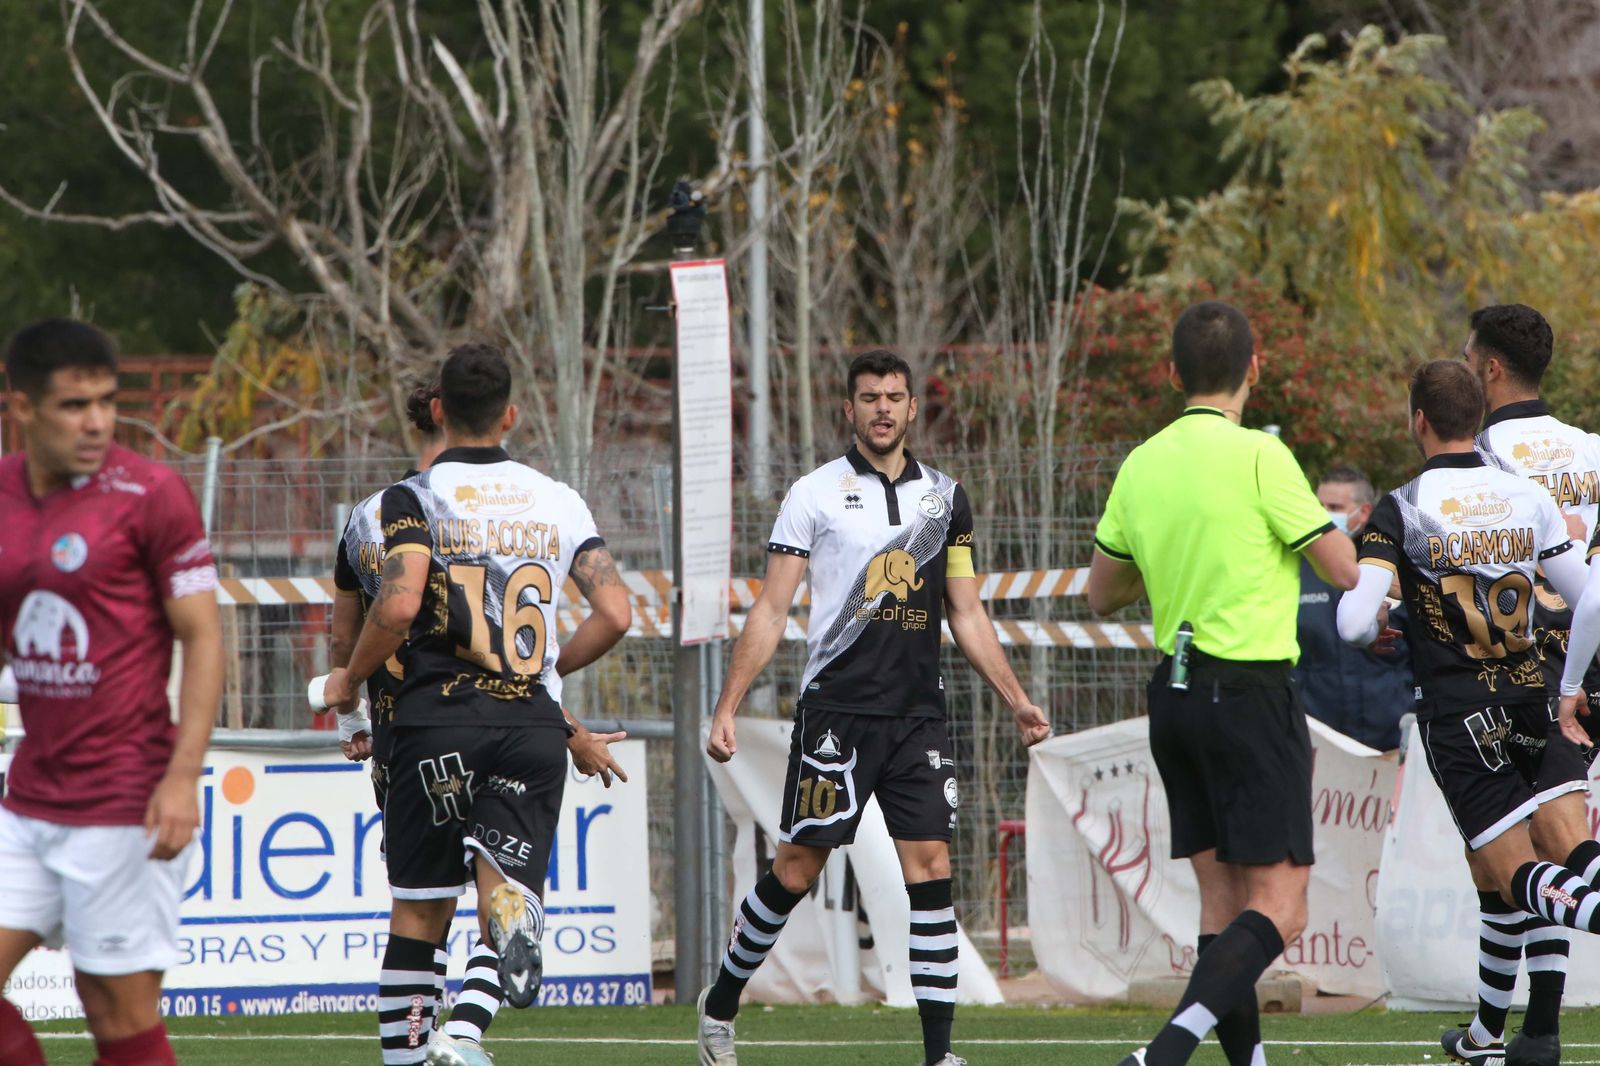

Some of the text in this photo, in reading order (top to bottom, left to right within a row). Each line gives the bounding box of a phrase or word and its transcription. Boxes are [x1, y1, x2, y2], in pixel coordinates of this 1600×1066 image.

[438, 518, 560, 561] LUIS ACOSTA
[1428, 527, 1534, 569] P.CARMONA
[448, 562, 552, 676] 16
[902, 621, 927, 631] grupo
[1439, 571, 1534, 660] 19
[798, 778, 836, 819] 10
[473, 823, 533, 860] DOZE
[1540, 885, 1578, 909] telepizza
[301, 932, 326, 960] Y
[175, 996, 197, 1016] 00
[202, 995, 222, 1016] 15
[539, 983, 569, 1007] 923
[572, 982, 595, 1005] 62
[598, 982, 620, 1004] 37
[624, 981, 646, 1004] 80
